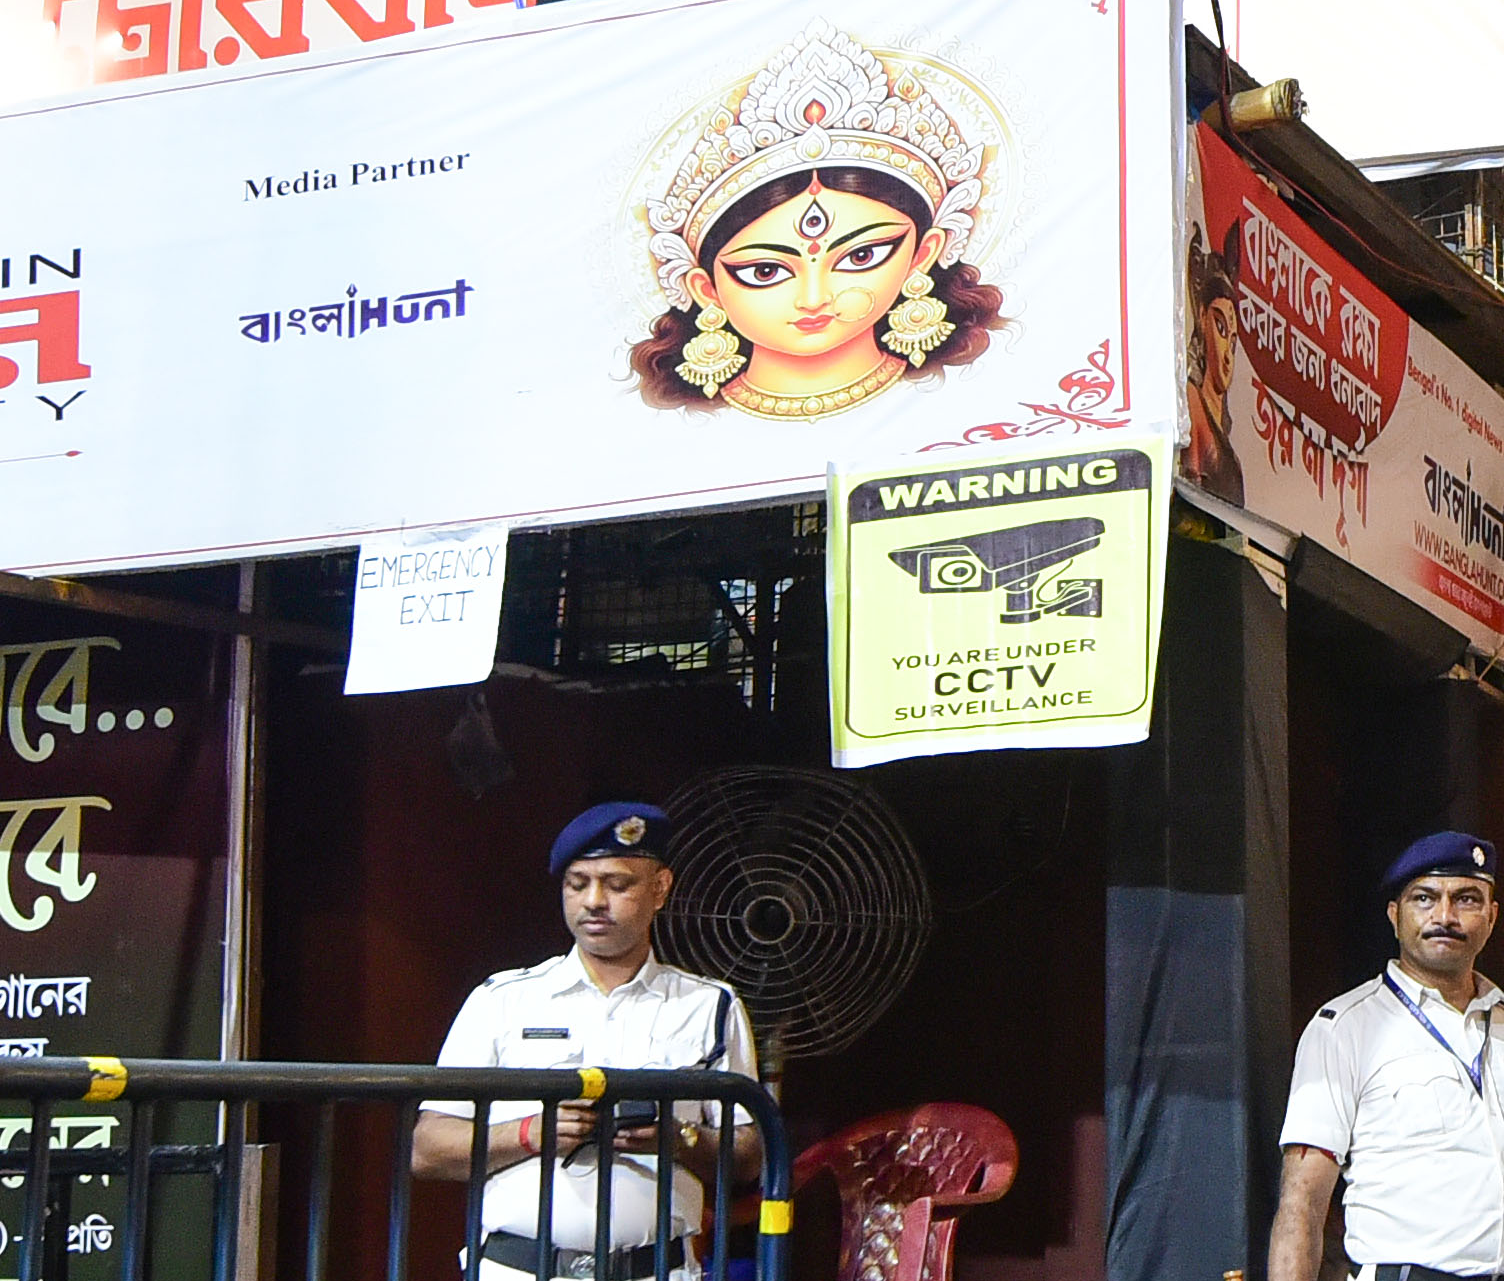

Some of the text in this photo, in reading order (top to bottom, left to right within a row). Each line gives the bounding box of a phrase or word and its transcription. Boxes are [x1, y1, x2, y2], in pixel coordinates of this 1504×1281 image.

[244, 152, 471, 201] Media Partner
[1242, 197, 1381, 379] বাংলাকে রক্ষা
[1239, 282, 1382, 435] করার জন্য ধন্যবাদ
[1407, 355, 1441, 406] Bengal's
[1461, 400, 1484, 441] digital
[1484, 421, 1503, 455] News
[1302, 412, 1326, 500] মা
[879, 458, 1119, 512] WARNING
[360, 544, 500, 591] EMERGENCY
[399, 588, 478, 627] EXIT
[893, 638, 1097, 671] YOU ARE UNDER
[933, 662, 1058, 699] CCTV
[894, 690, 1094, 721] SURVEILLANCE
